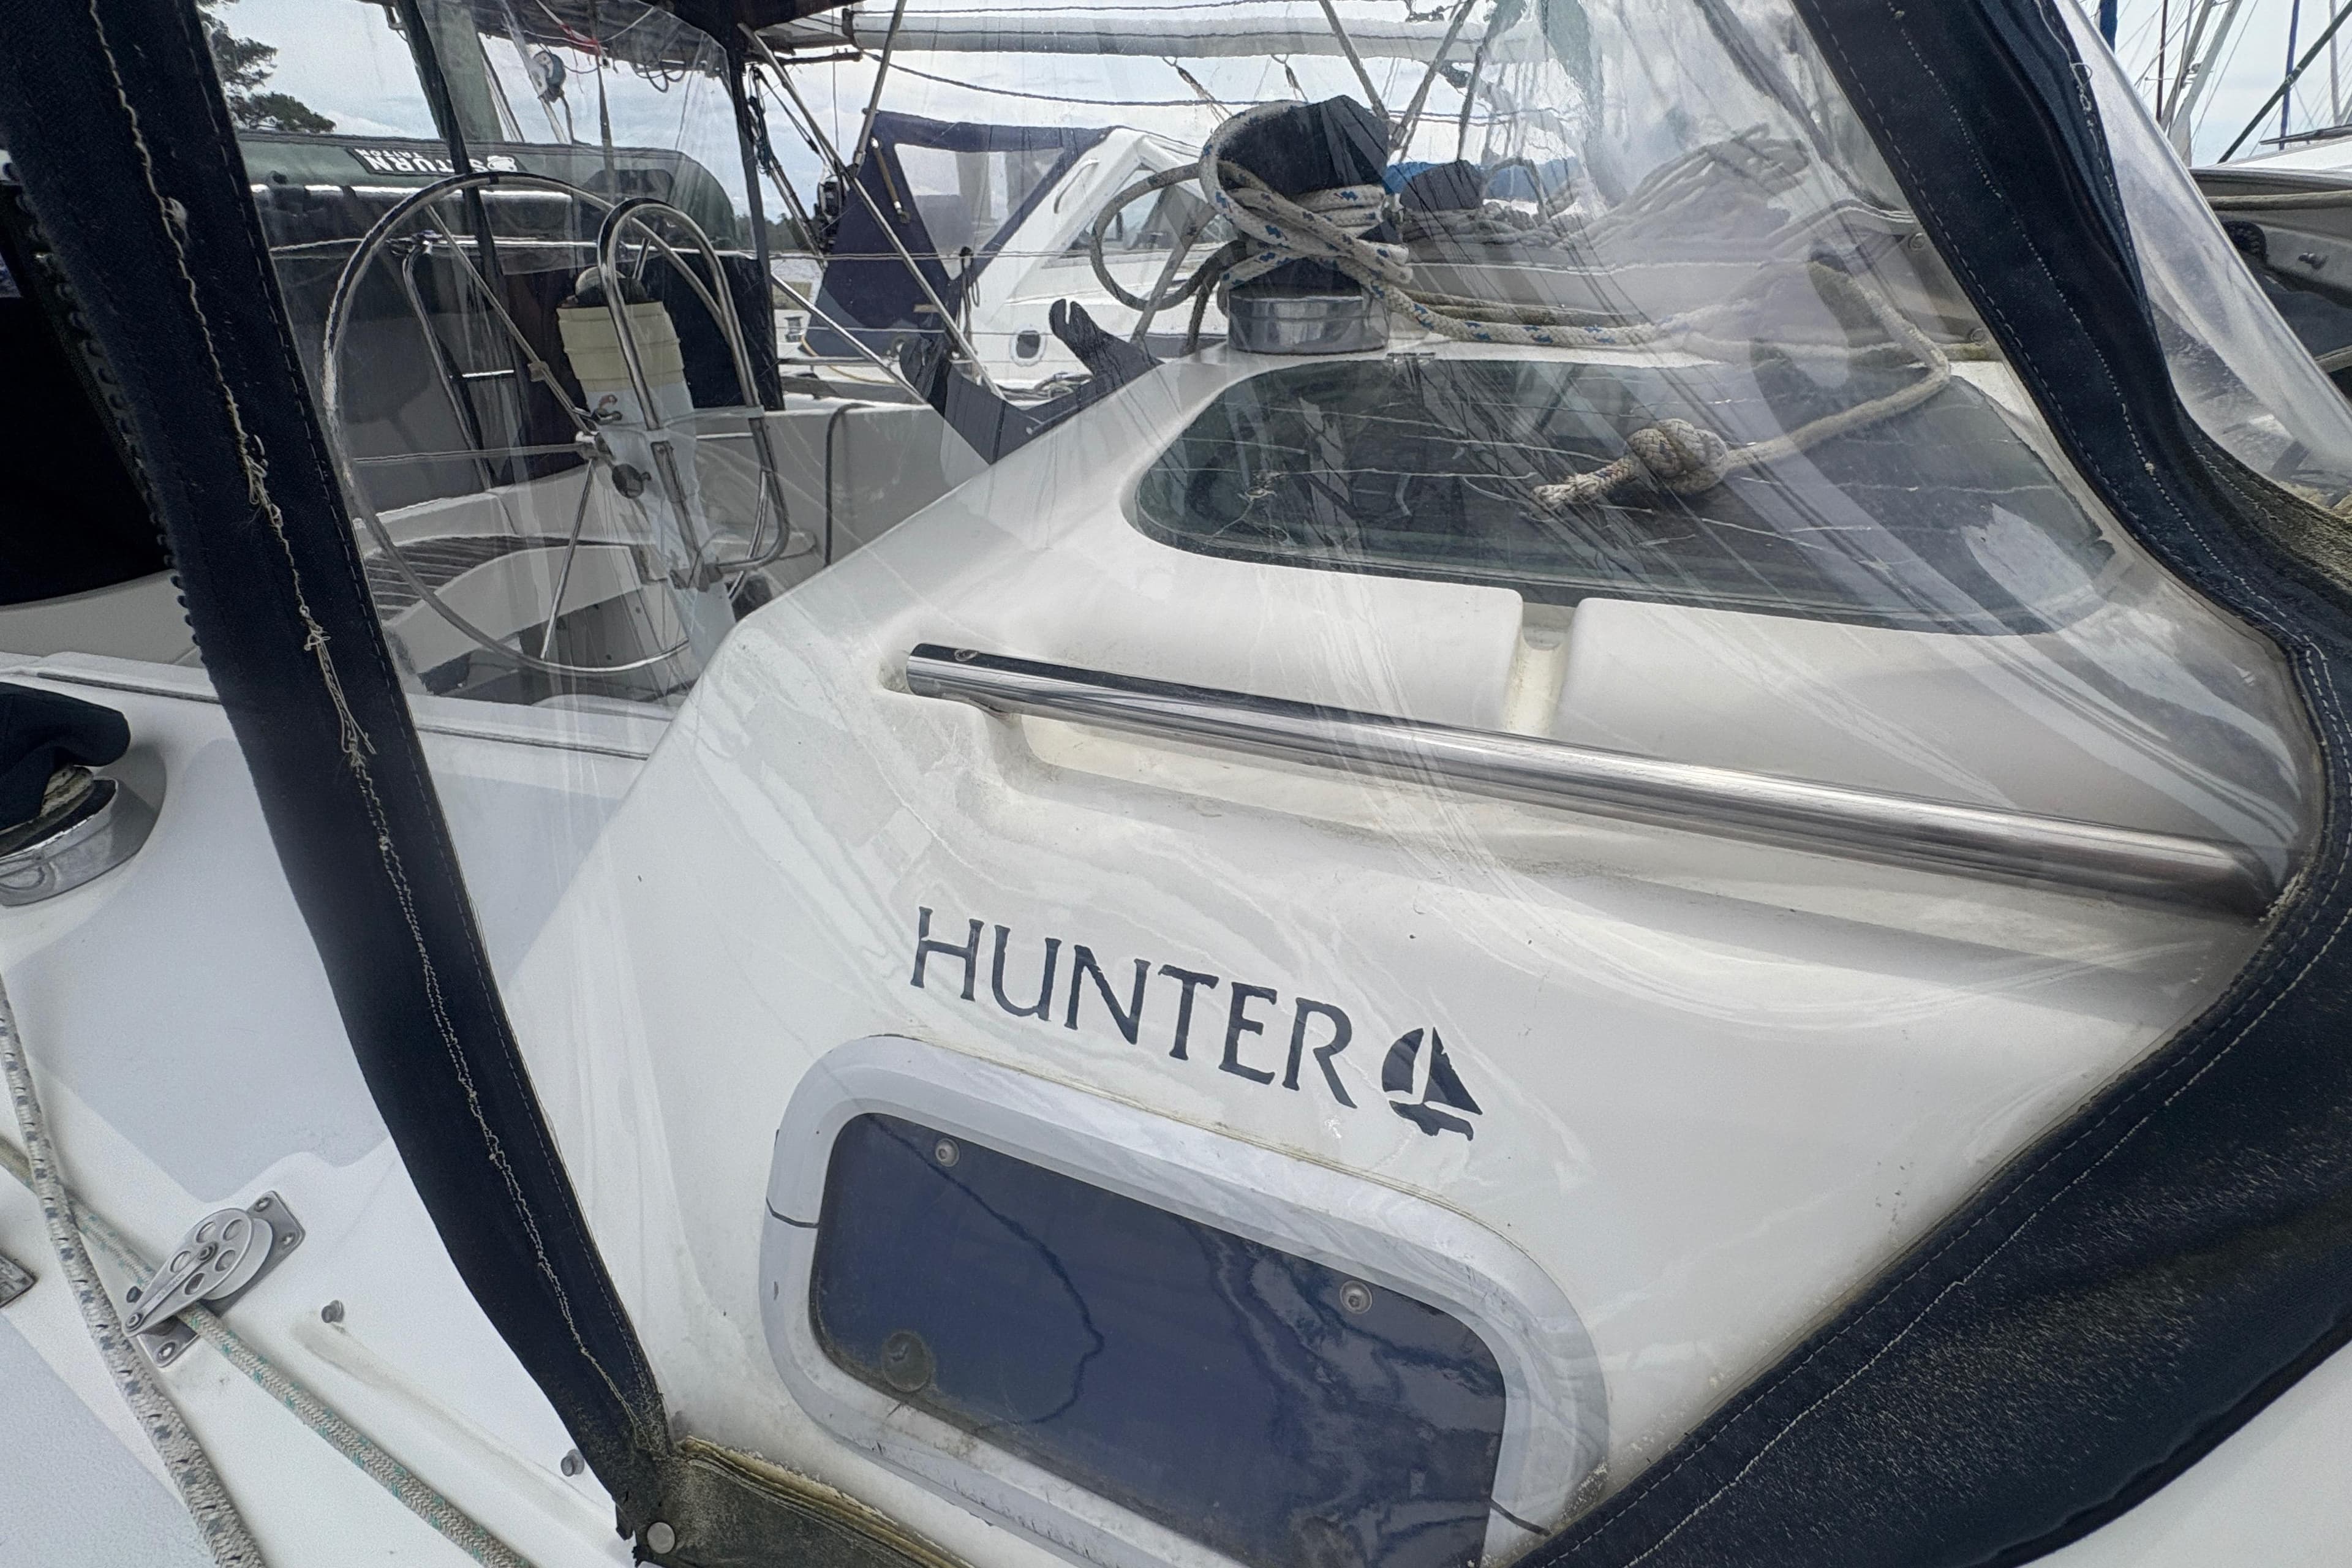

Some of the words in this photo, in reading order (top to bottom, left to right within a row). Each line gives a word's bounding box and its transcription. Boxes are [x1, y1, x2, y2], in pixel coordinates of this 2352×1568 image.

[354, 148, 423, 159] TRITON
[363, 156, 489, 173] STURN
[910, 906, 1357, 1109] HUNTER
